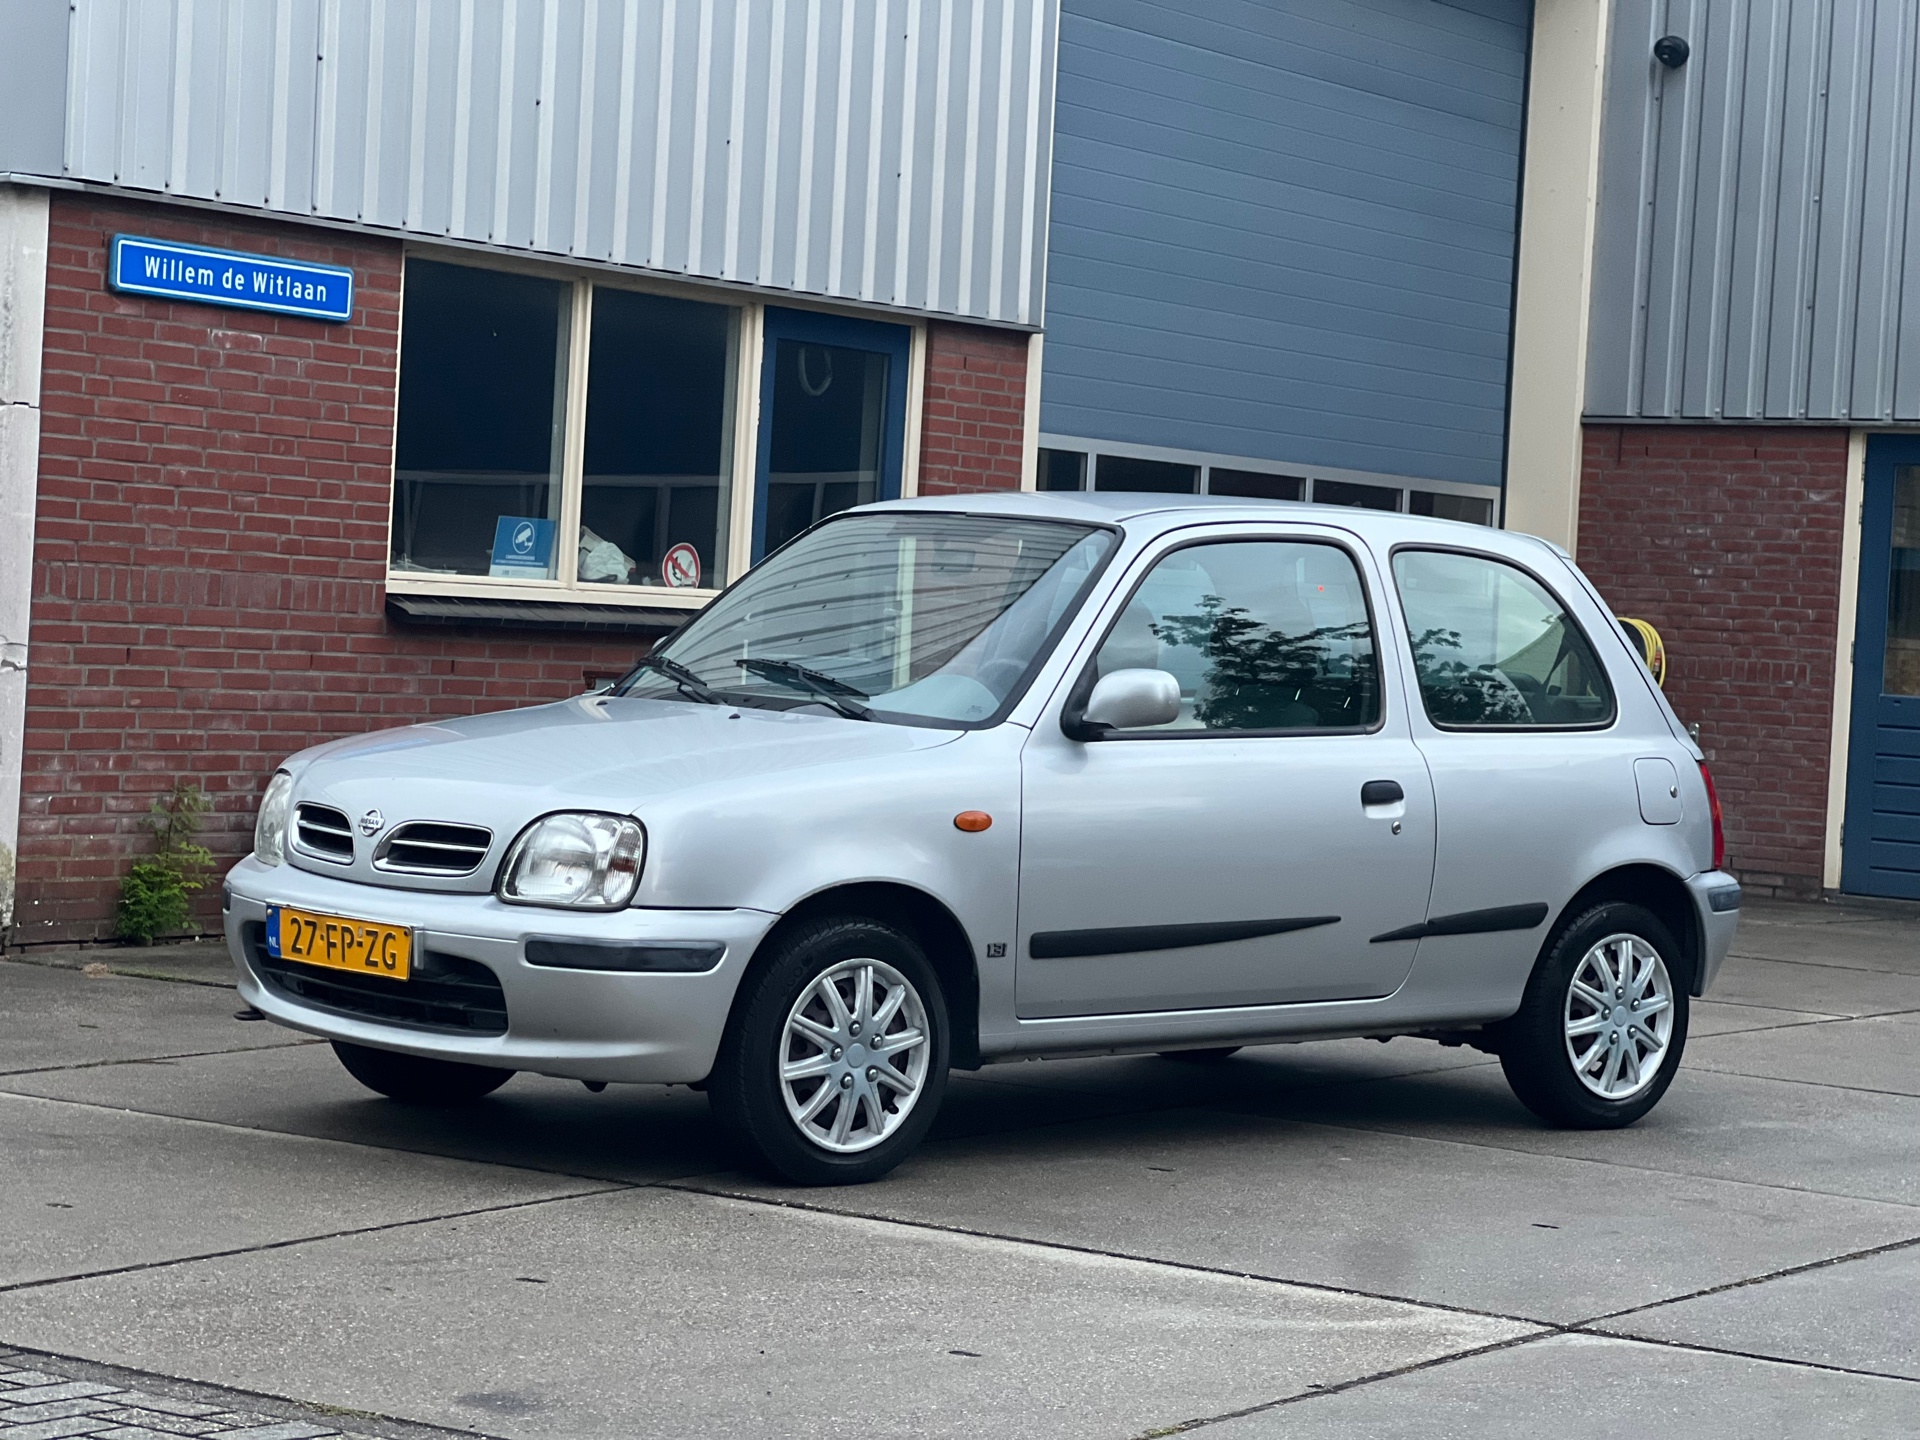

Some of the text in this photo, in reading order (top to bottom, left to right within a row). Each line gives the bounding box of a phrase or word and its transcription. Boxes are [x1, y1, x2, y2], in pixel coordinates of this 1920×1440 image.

[145, 255, 327, 302] Willem de Witlaan
[268, 936, 279, 948] NL
[290, 918, 397, 970] 27-FP-ZG
